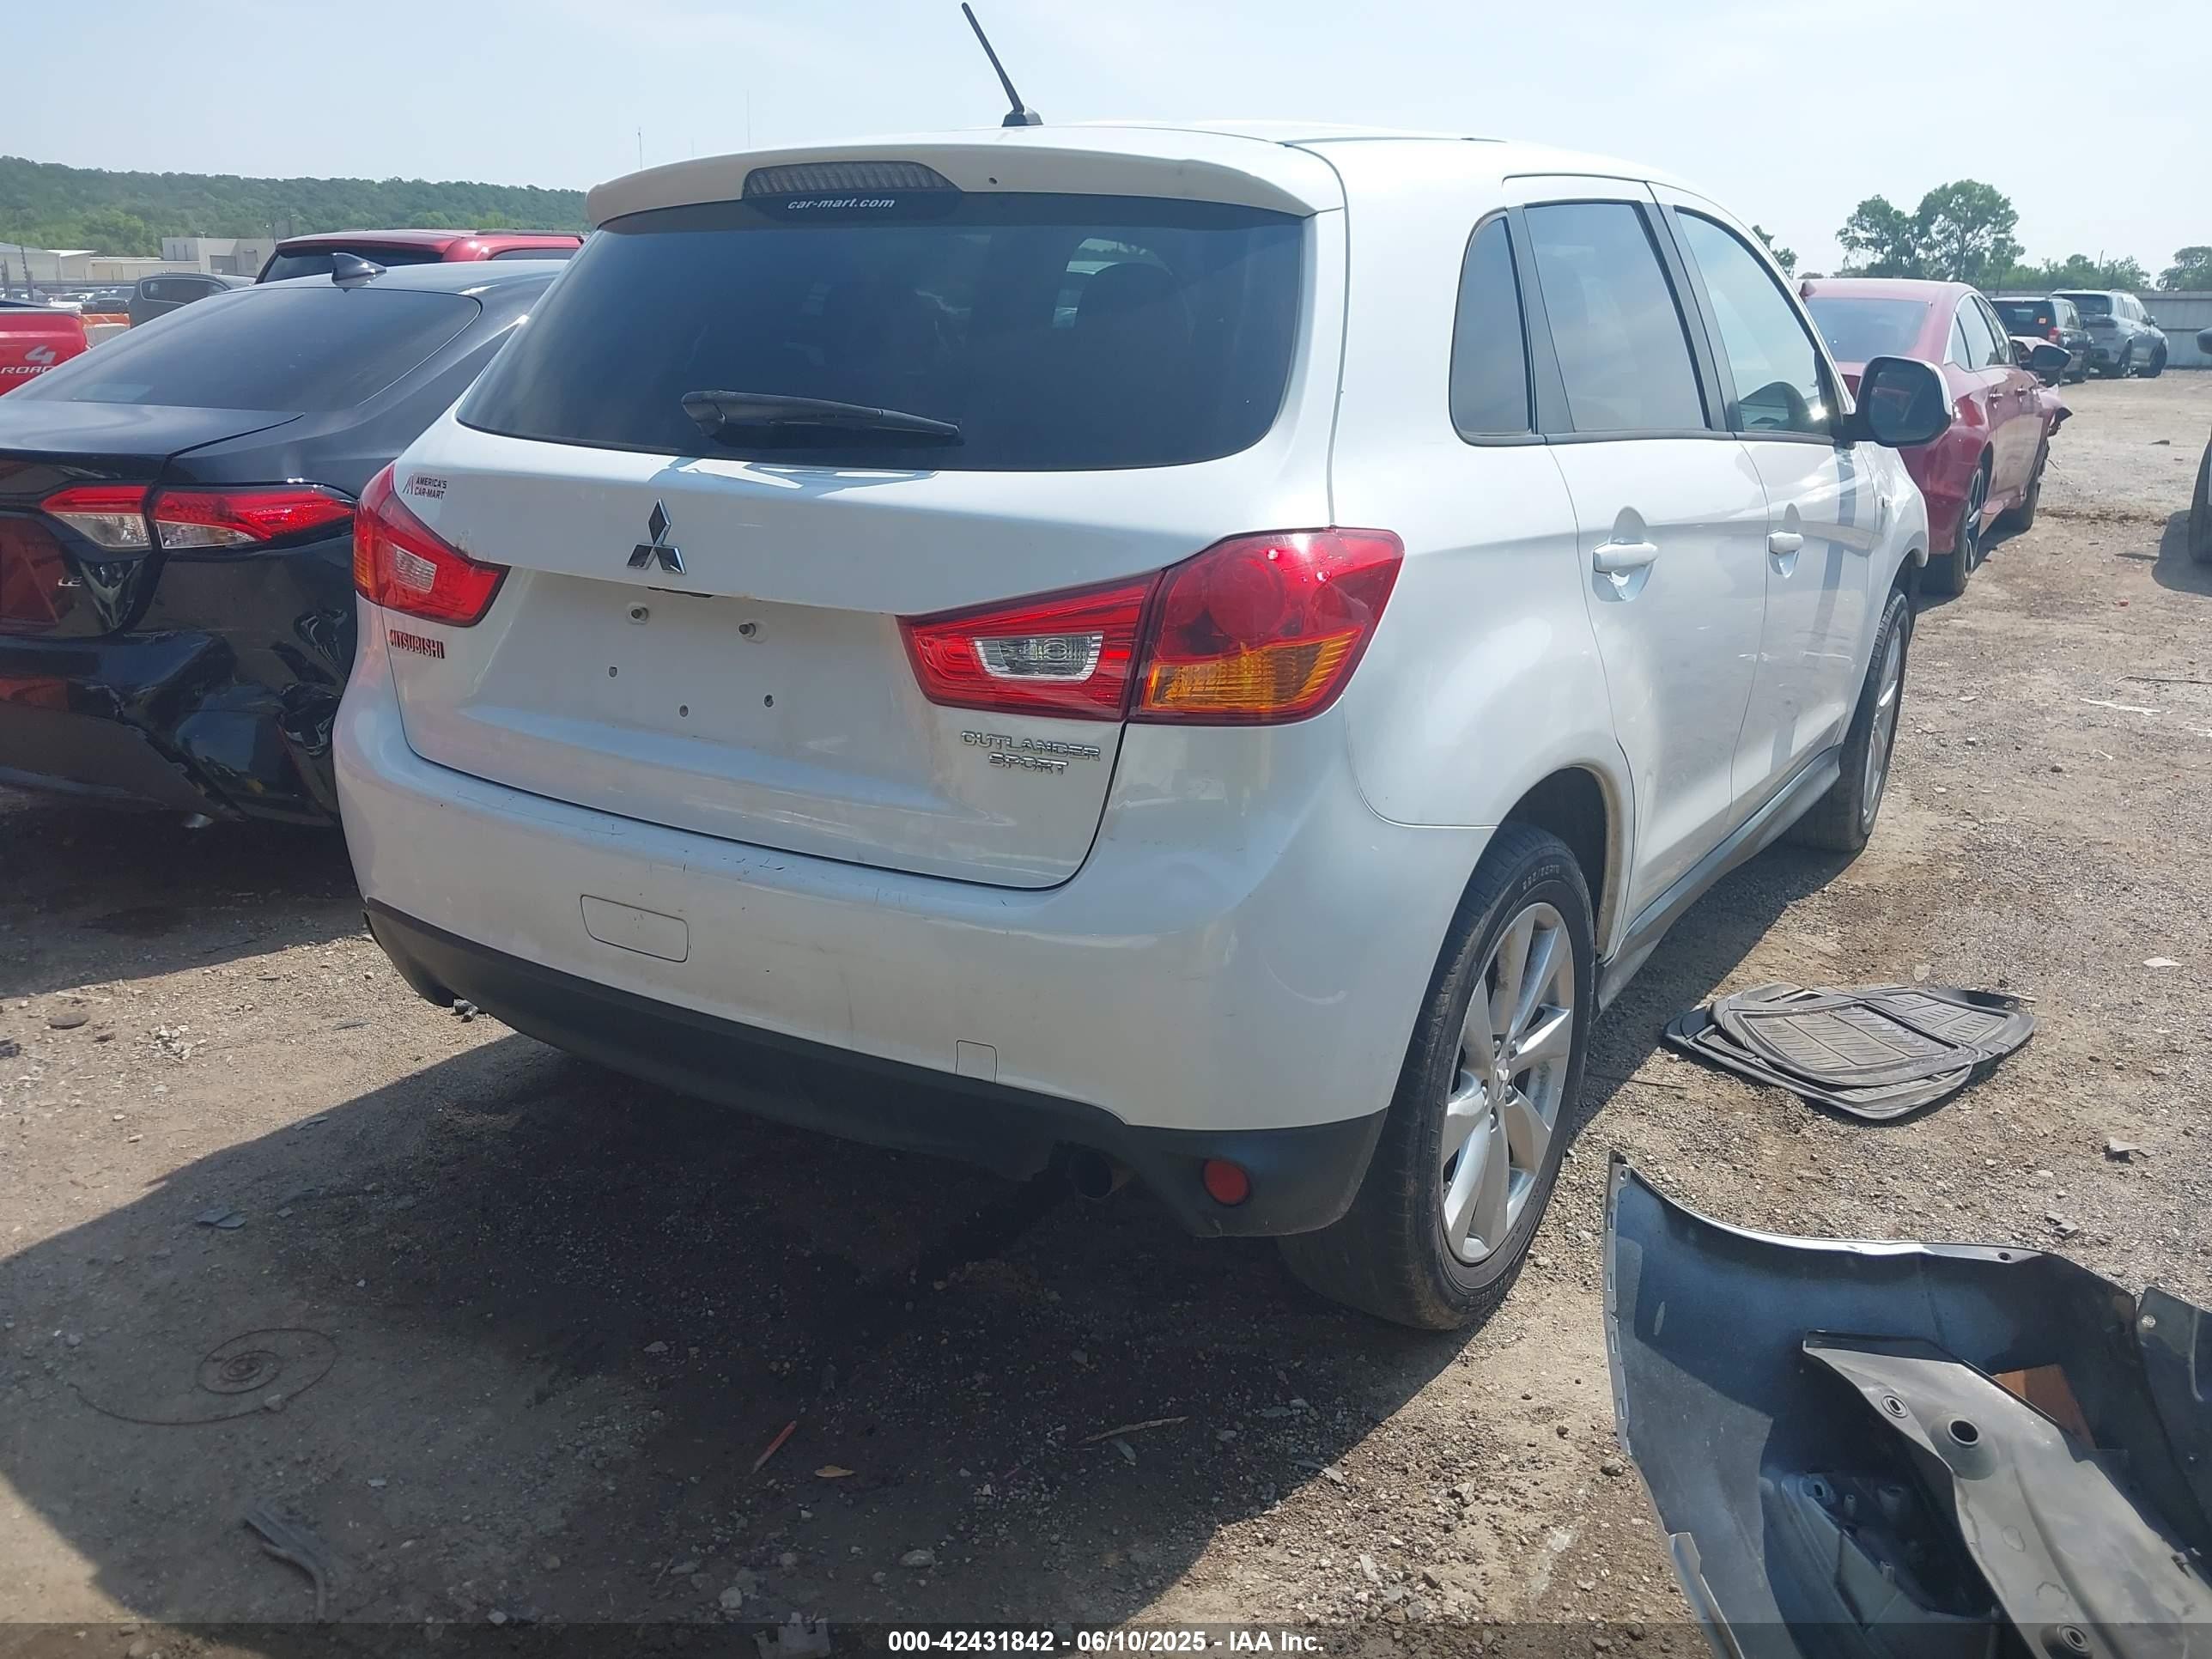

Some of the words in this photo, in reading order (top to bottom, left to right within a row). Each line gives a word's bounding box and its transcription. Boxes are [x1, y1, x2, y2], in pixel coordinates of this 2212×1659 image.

[787, 198, 895, 210] car-mart.com
[416, 477, 447, 489] AMERICA'S
[414, 486, 445, 500] CAR-MART
[961, 730, 1101, 762] OUTLANDER
[988, 751, 1069, 775] SPORT
